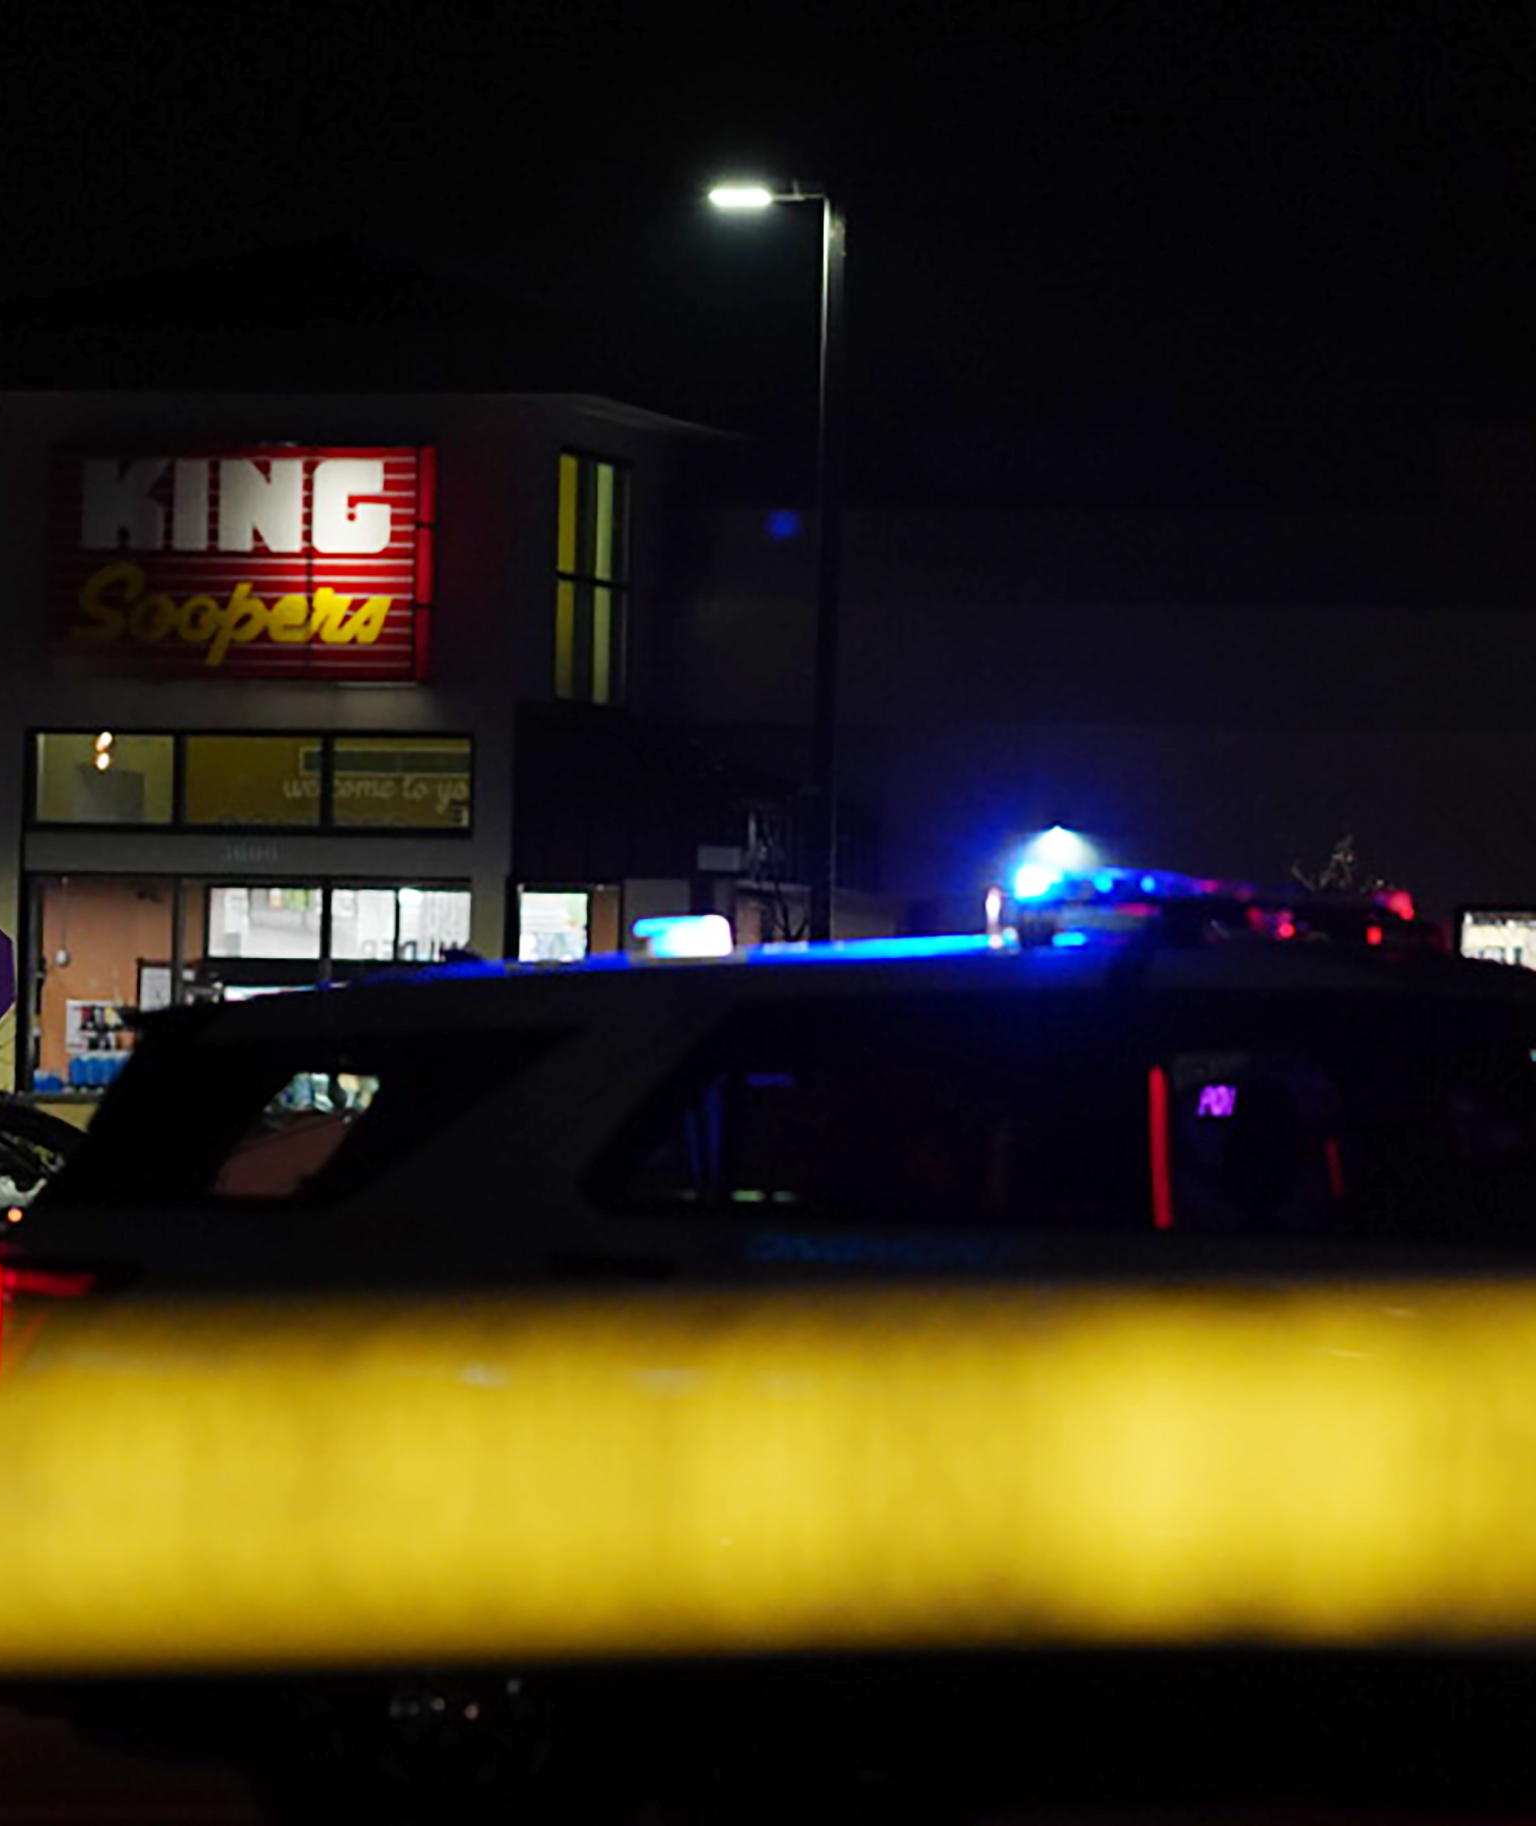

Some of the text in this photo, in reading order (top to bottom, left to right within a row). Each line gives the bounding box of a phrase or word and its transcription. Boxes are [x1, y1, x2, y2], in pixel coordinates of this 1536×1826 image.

[81, 457, 392, 555] KING
[70, 560, 392, 667] Soopers
[282, 774, 395, 800] weome
